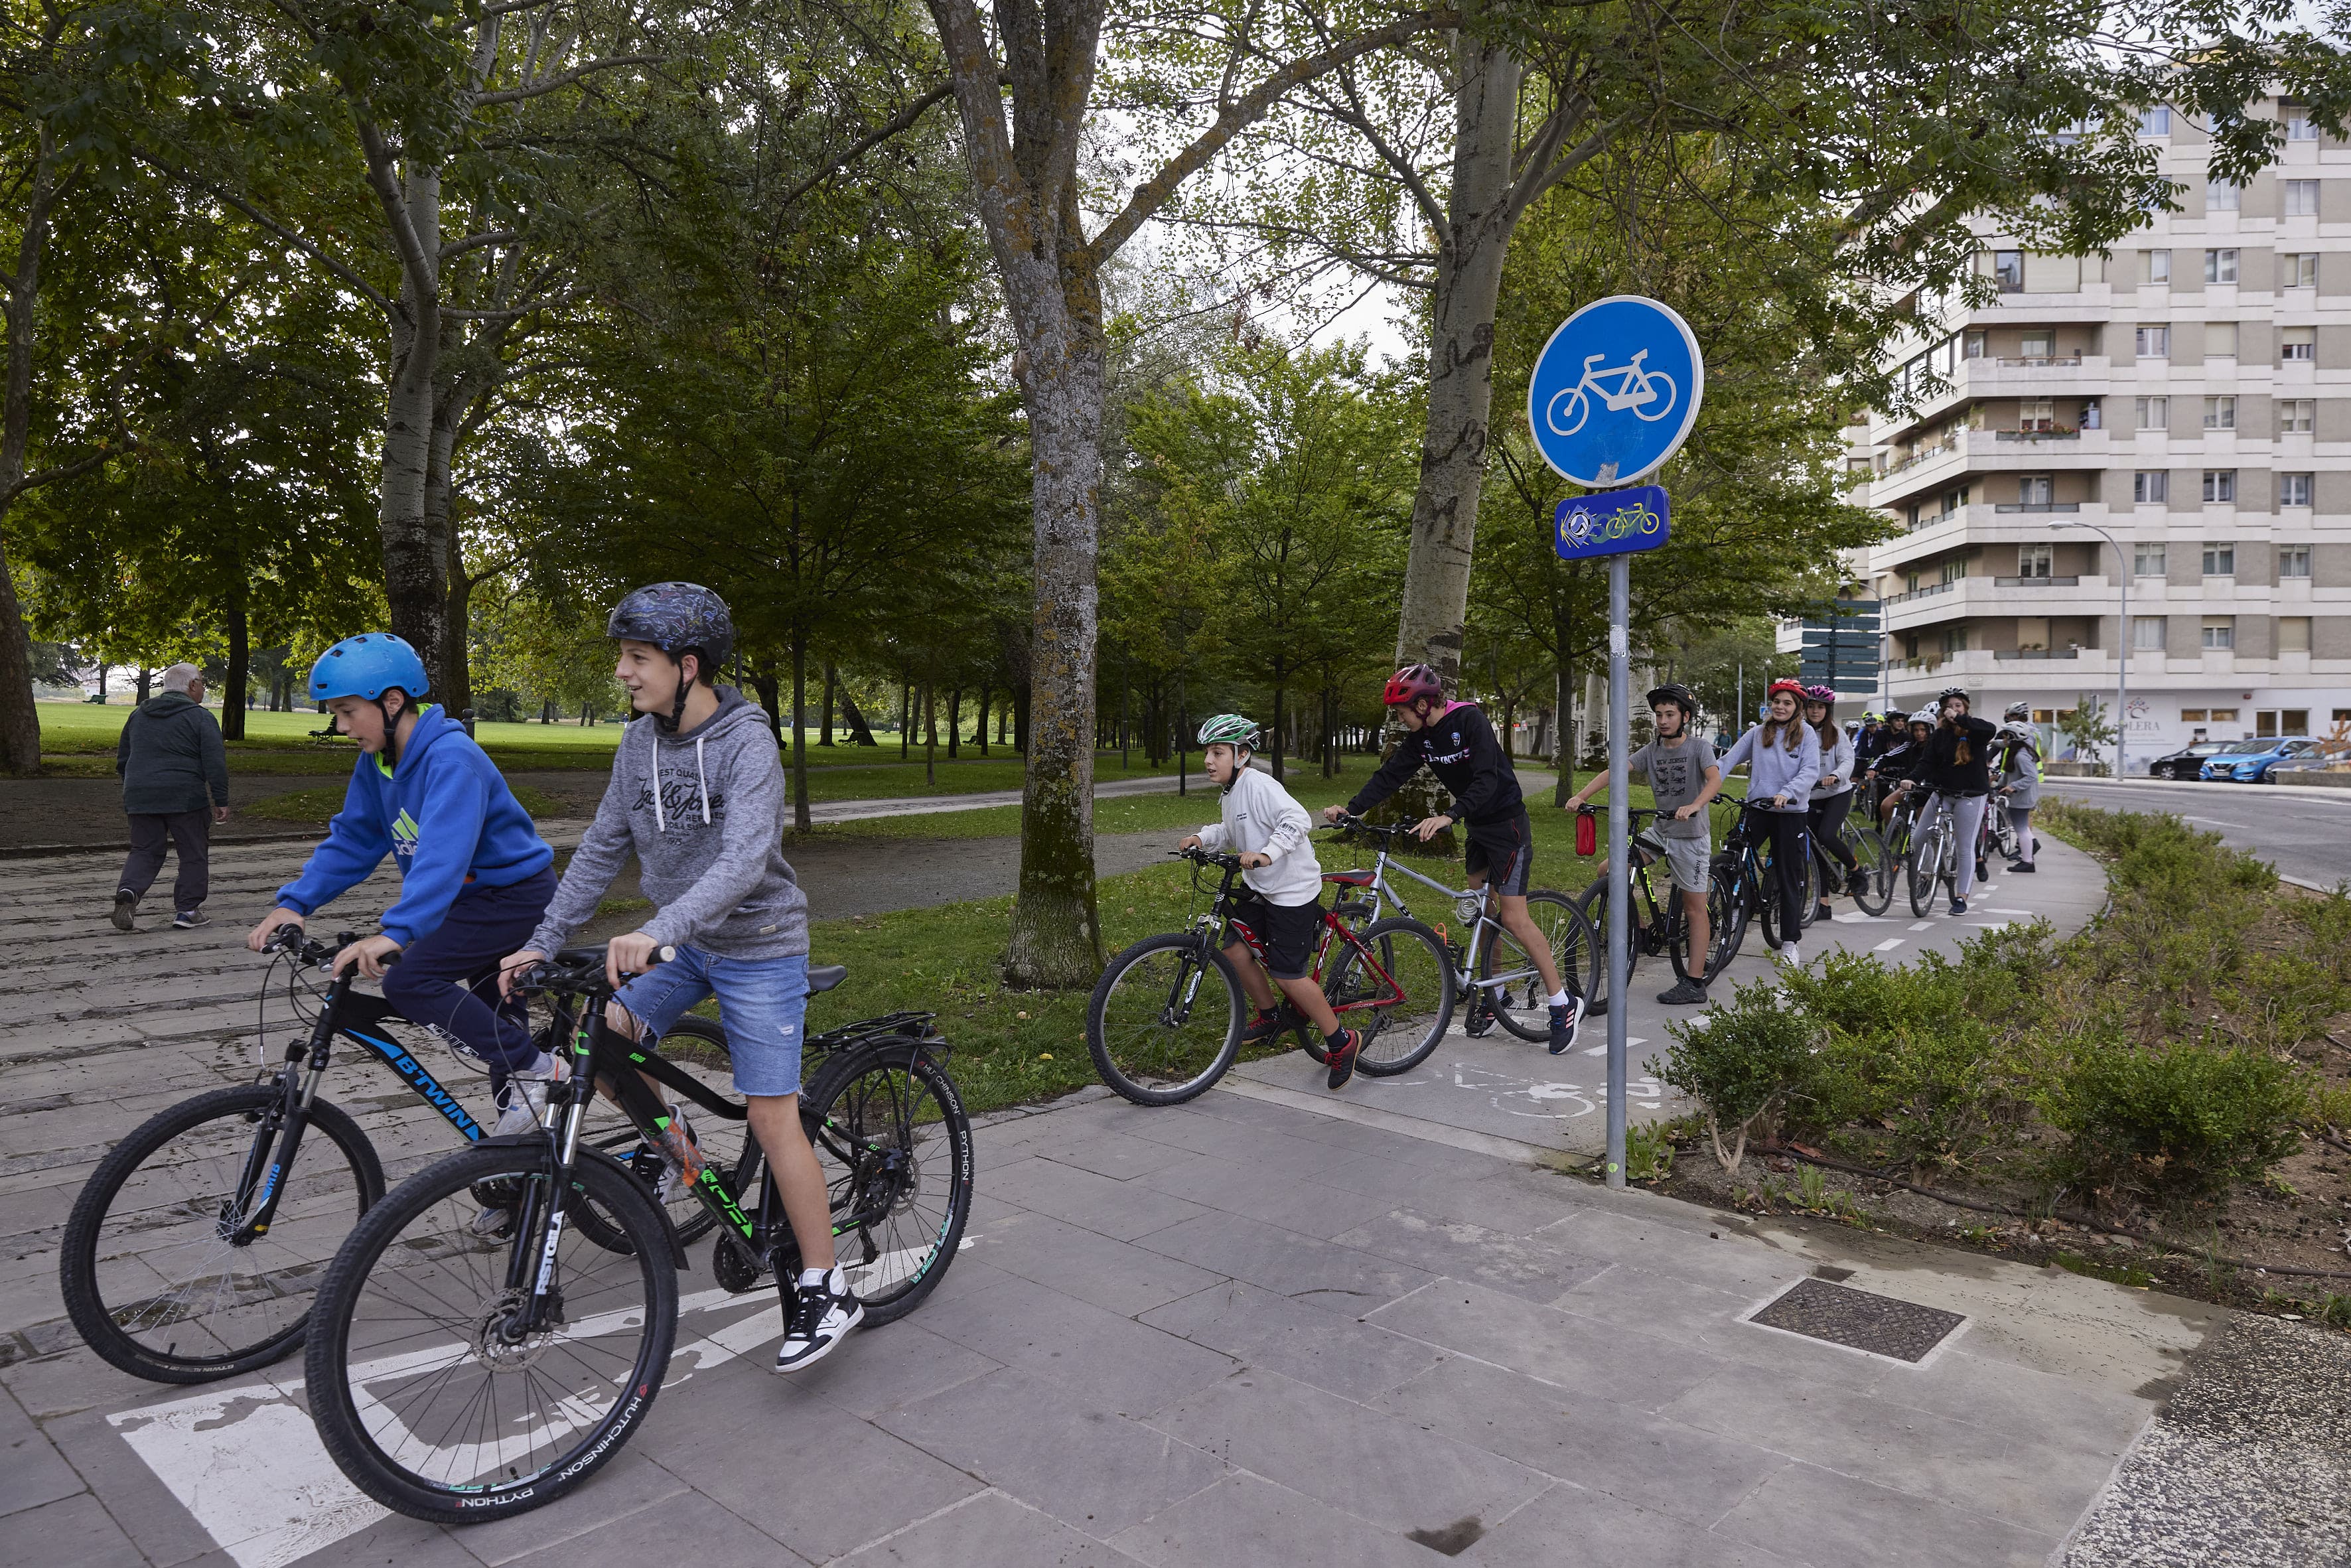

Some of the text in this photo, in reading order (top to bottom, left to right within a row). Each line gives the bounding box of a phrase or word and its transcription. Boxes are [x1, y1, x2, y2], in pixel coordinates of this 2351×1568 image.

[924, 1064, 960, 1114] HUCHINSON
[960, 1131, 969, 1180] PYTHON
[561, 1396, 642, 1480] HUTCHINSON
[462, 1488, 534, 1508] PYTHON
